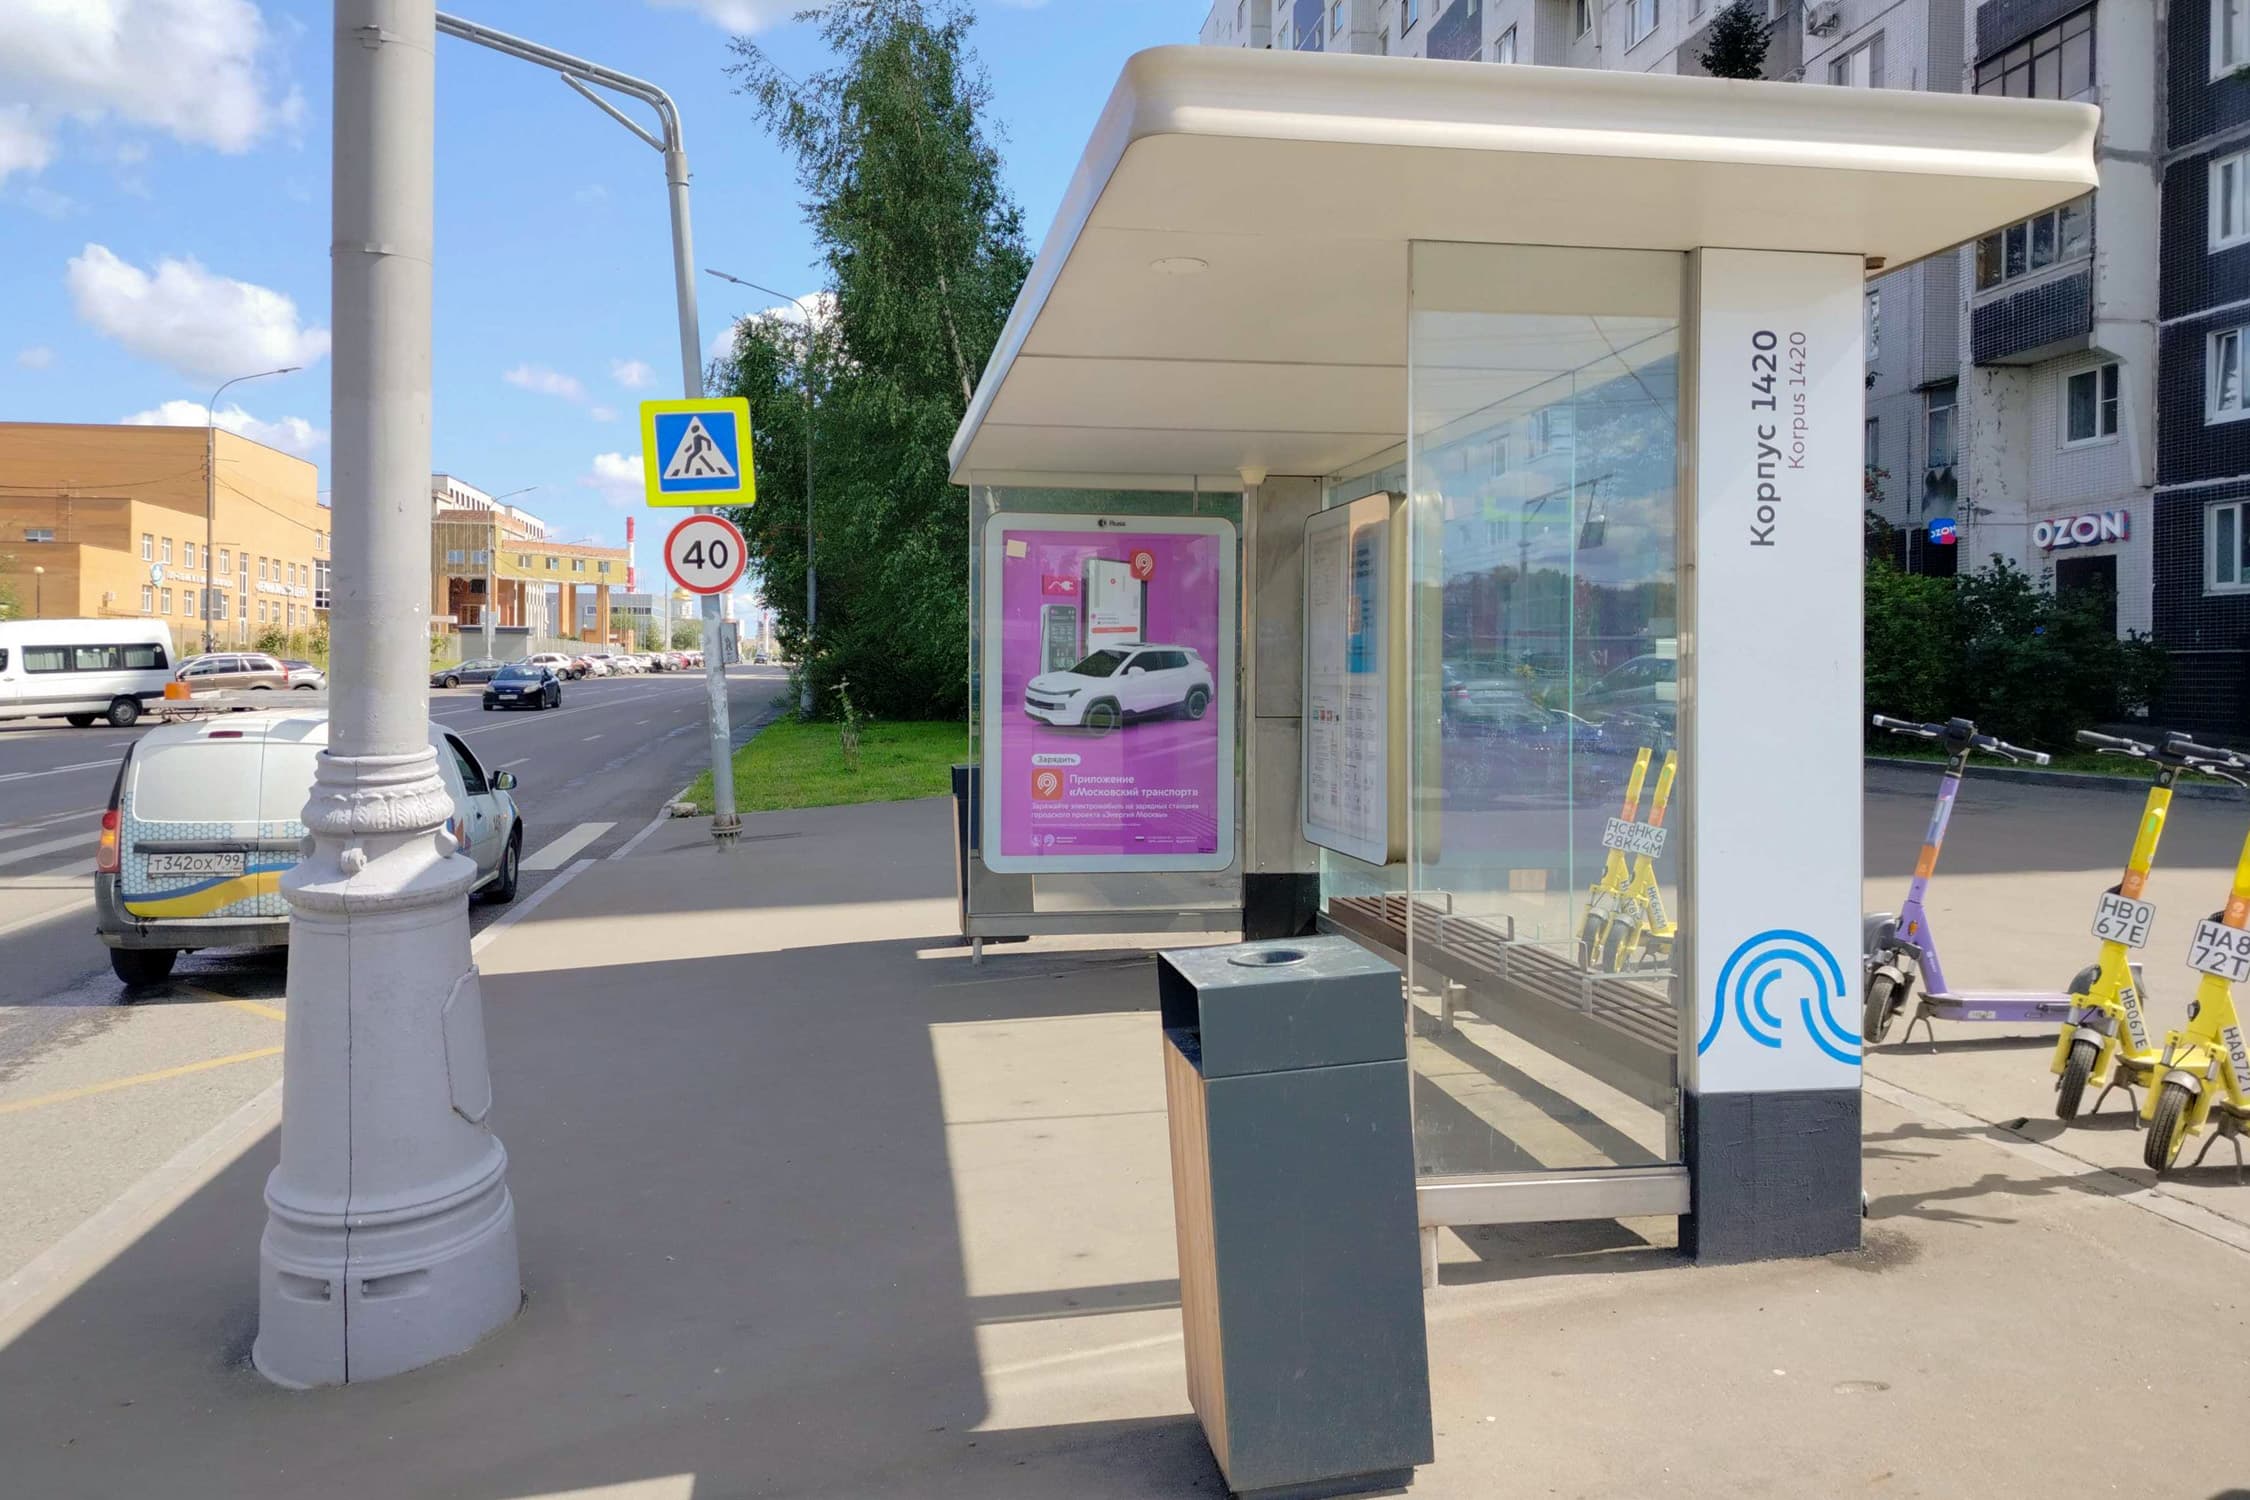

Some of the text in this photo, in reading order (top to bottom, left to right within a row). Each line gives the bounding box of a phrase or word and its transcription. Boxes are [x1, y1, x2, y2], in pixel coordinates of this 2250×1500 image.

[1788, 331, 1808, 469] Korpus 1420
[1750, 330, 1782, 546] Корпус 1420
[2033, 511, 2128, 549] OZON
[682, 540, 728, 569] 40
[1069, 774, 1135, 785] Приложение
[1069, 787, 1139, 797] «Московский
[1604, 833, 1632, 849] 28K
[1608, 820, 1635, 837] HC8
[1634, 823, 1663, 843] HK6
[1633, 838, 1662, 857] 44M
[154, 854, 241, 871] Т342ОХ 799
[2100, 897, 2149, 924] HB0
[2097, 917, 2144, 943] 67E
[2198, 924, 2250, 956] HA8
[2195, 945, 2249, 976] 72T
[2120, 988, 2148, 1048] HB067E
